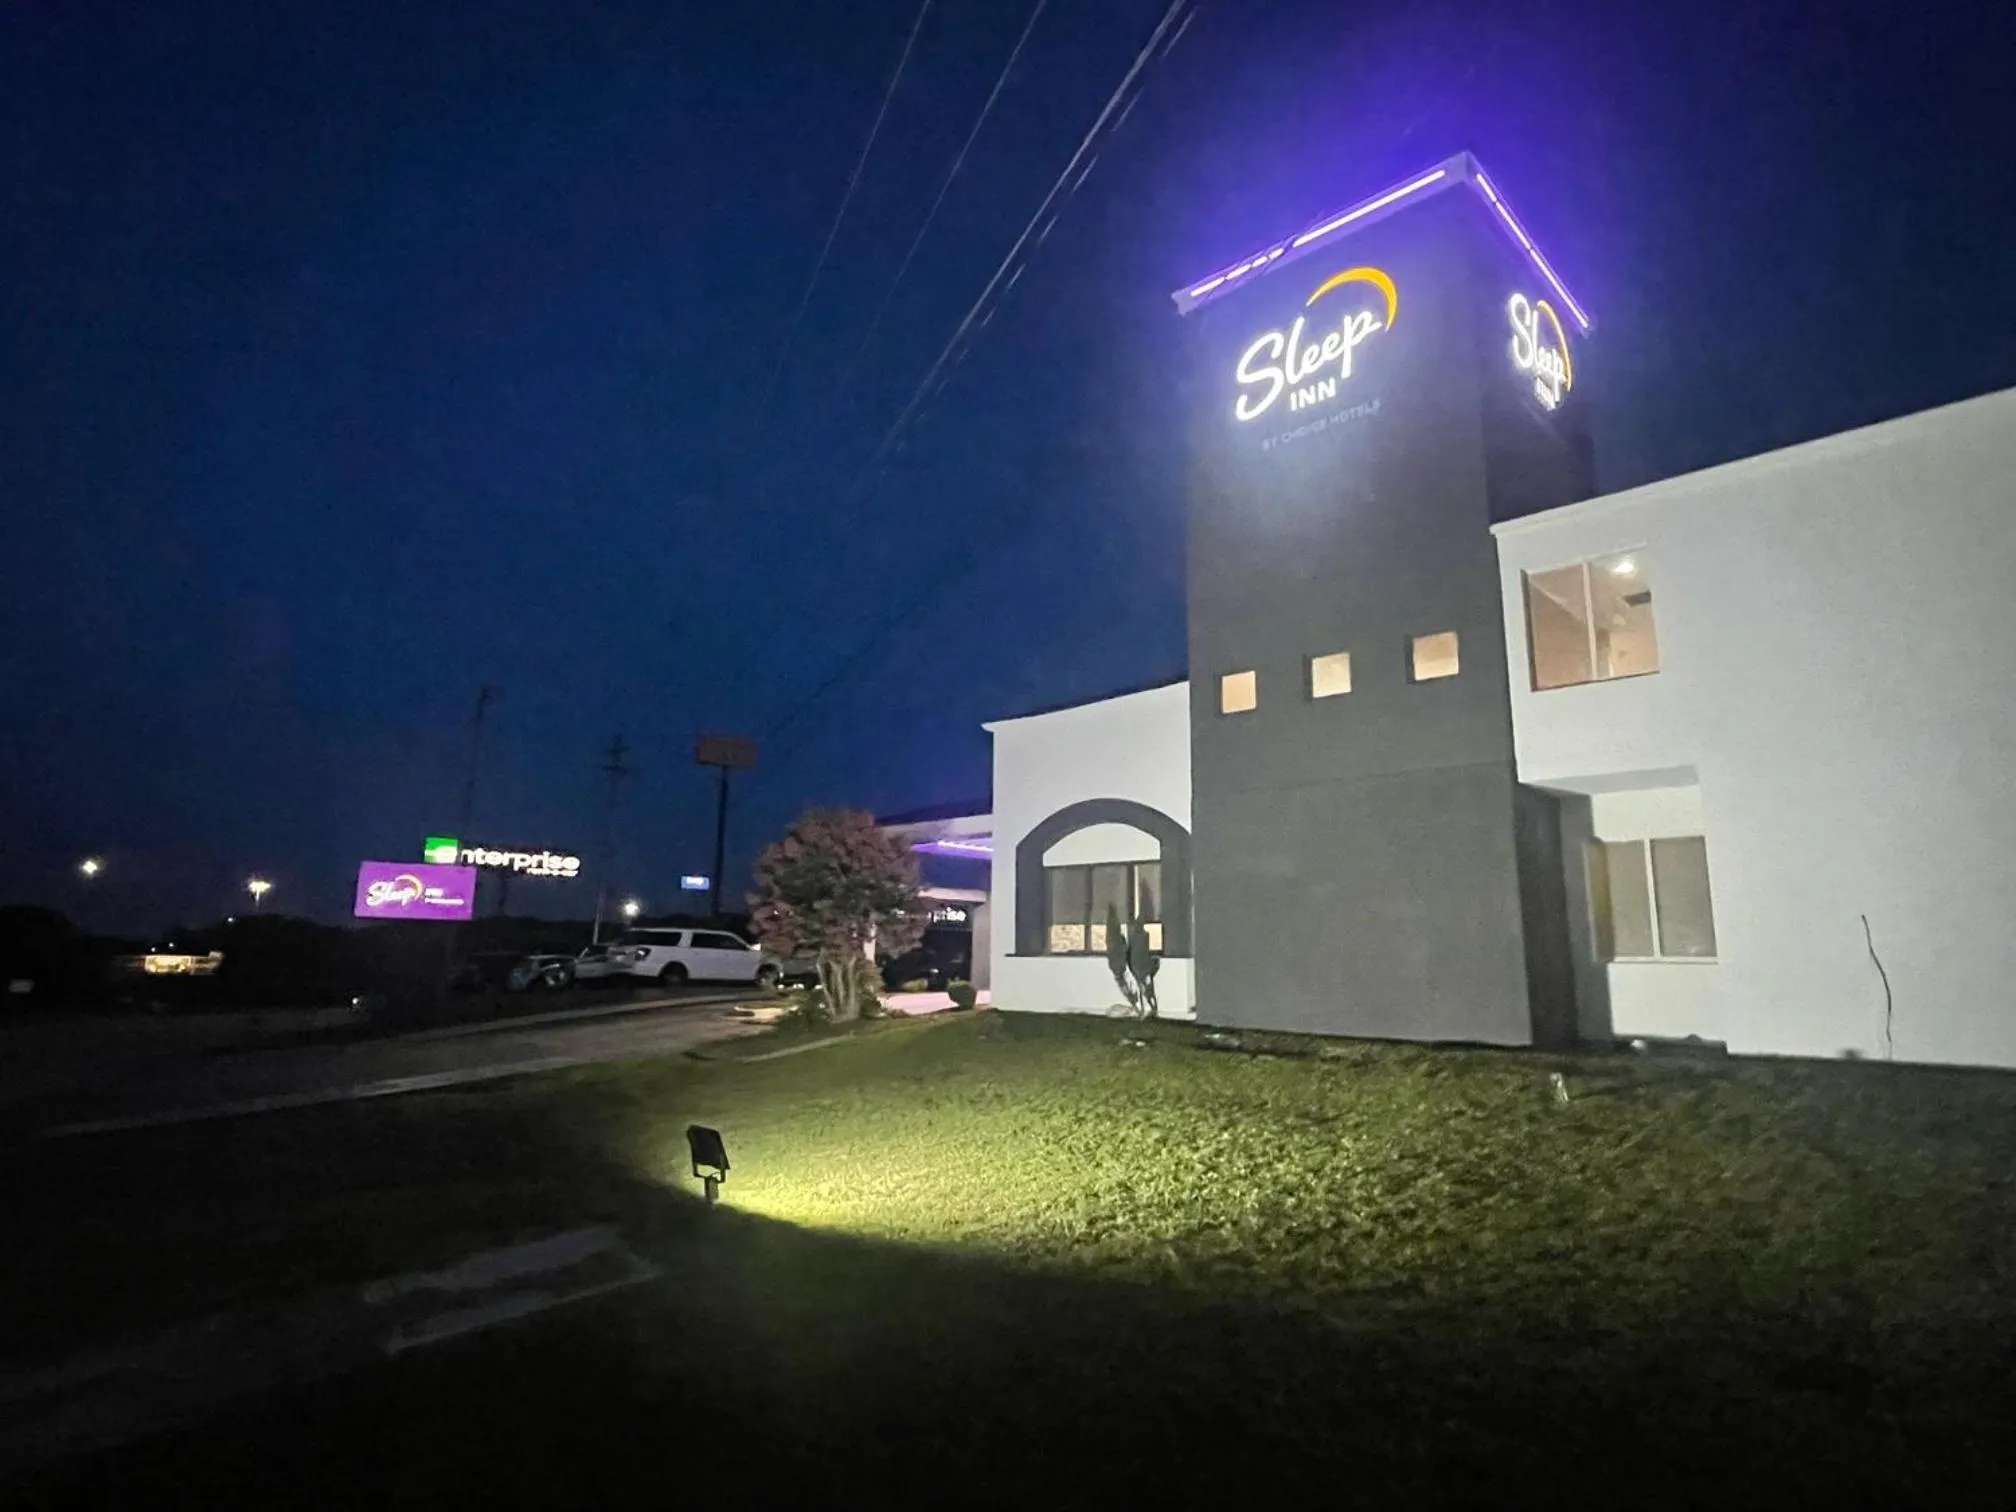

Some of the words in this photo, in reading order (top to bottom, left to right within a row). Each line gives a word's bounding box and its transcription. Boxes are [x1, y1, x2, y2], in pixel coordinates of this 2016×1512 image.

[1235, 310, 1382, 422] Sleep
[1290, 377, 1337, 412] INN
[1510, 293, 1567, 401] Sleep
